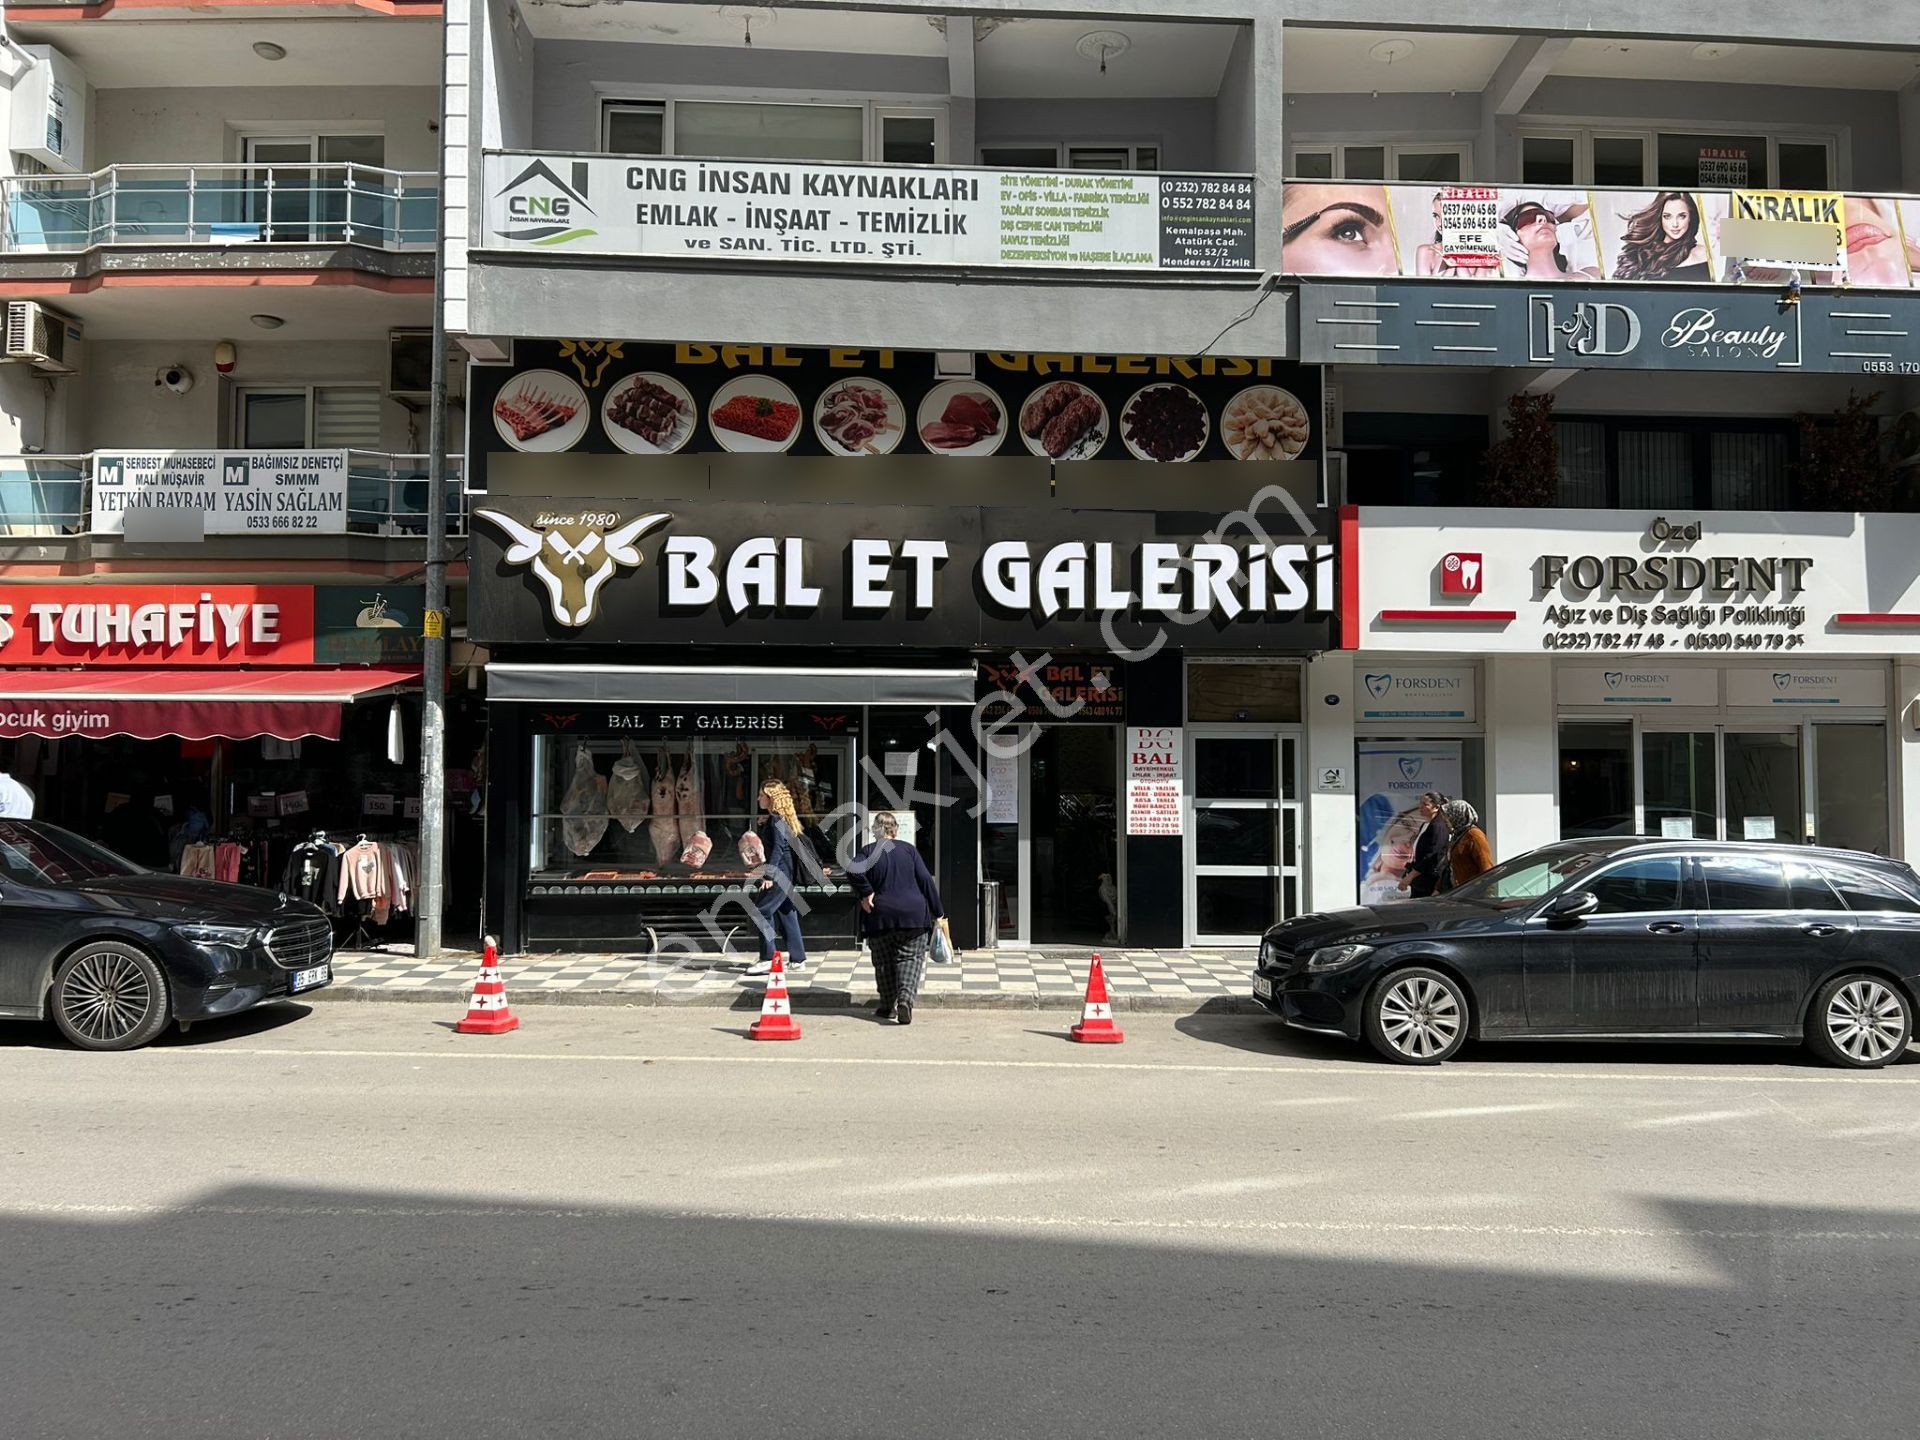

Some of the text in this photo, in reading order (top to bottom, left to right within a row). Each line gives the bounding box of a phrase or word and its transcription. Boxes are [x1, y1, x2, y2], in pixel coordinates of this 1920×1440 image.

[626, 163, 979, 201] CNG İNSAN KAYNAKLARI
[1065, 178, 1094, 189] DURAK
[1201, 182, 1220, 193] 782
[1222, 183, 1236, 193] 84
[1238, 184, 1251, 194] 84
[509, 196, 570, 216] CNG
[1162, 197, 1251, 210] 0 552 782 84 84
[1443, 203, 1497, 215] 0537 690 45 68
[636, 202, 967, 236] EMLAK İNŞAAT TEMİZLİK
[1444, 217, 1497, 229] 0545 696 45 68
[1166, 227, 1247, 236] Kemalpaşa Mah.
[1175, 237, 1238, 246] Atatürk Cad.
[1459, 235, 1482, 243] EFE
[684, 239, 711, 250] ve
[719, 237, 772, 251] SAN.
[831, 242, 873, 255] LTD.
[882, 239, 921, 258] ŞTİ.
[1185, 248, 1228, 257] No: 52/2
[1162, 258, 1211, 266] Menderes
[1221, 258, 1250, 267] İZMİR
[1661, 307, 1787, 359] Beauty
[1863, 361, 1920, 372] 0553 170
[125, 454, 216, 470] SERBEST MUHASEBECİ
[251, 453, 343, 473] BAĞIMSIZ DENETÇİ
[161, 472, 205, 488] MÜŞAVİR
[275, 474, 319, 486] SMMM
[98, 488, 216, 511] YETKİN BAYRAM
[224, 487, 342, 512] YASİN SAĞLAM
[247, 516, 318, 528] 0533 666 82 22
[536, 512, 575, 525] since
[1652, 517, 1702, 541] Özel
[664, 535, 823, 615] BAL
[852, 538, 949, 609] ET
[1540, 555, 1813, 592] FORSDENT
[29, 593, 281, 648] TUHAFİYE
[1546, 605, 1806, 627] Ağız ve Diş Sağlığı Polikliniği
[1545, 632, 1591, 648] 0(232)
[1624, 633, 1643, 647] 47
[1687, 633, 1732, 649] 0(530)
[1735, 633, 1762, 648] 540
[1765, 633, 1784, 648] 79
[1046, 666, 1084, 681] BAL
[1624, 675, 1670, 683] FORSDENT
[1793, 676, 1837, 684] FORSDENT
[1395, 678, 1461, 689] FORSDENT
[52, 710, 110, 732] giyim
[608, 713, 784, 729] BAL ET GALERİSİ
[1131, 752, 1178, 765] BAL
[1388, 782, 1433, 790] FORSDENT
